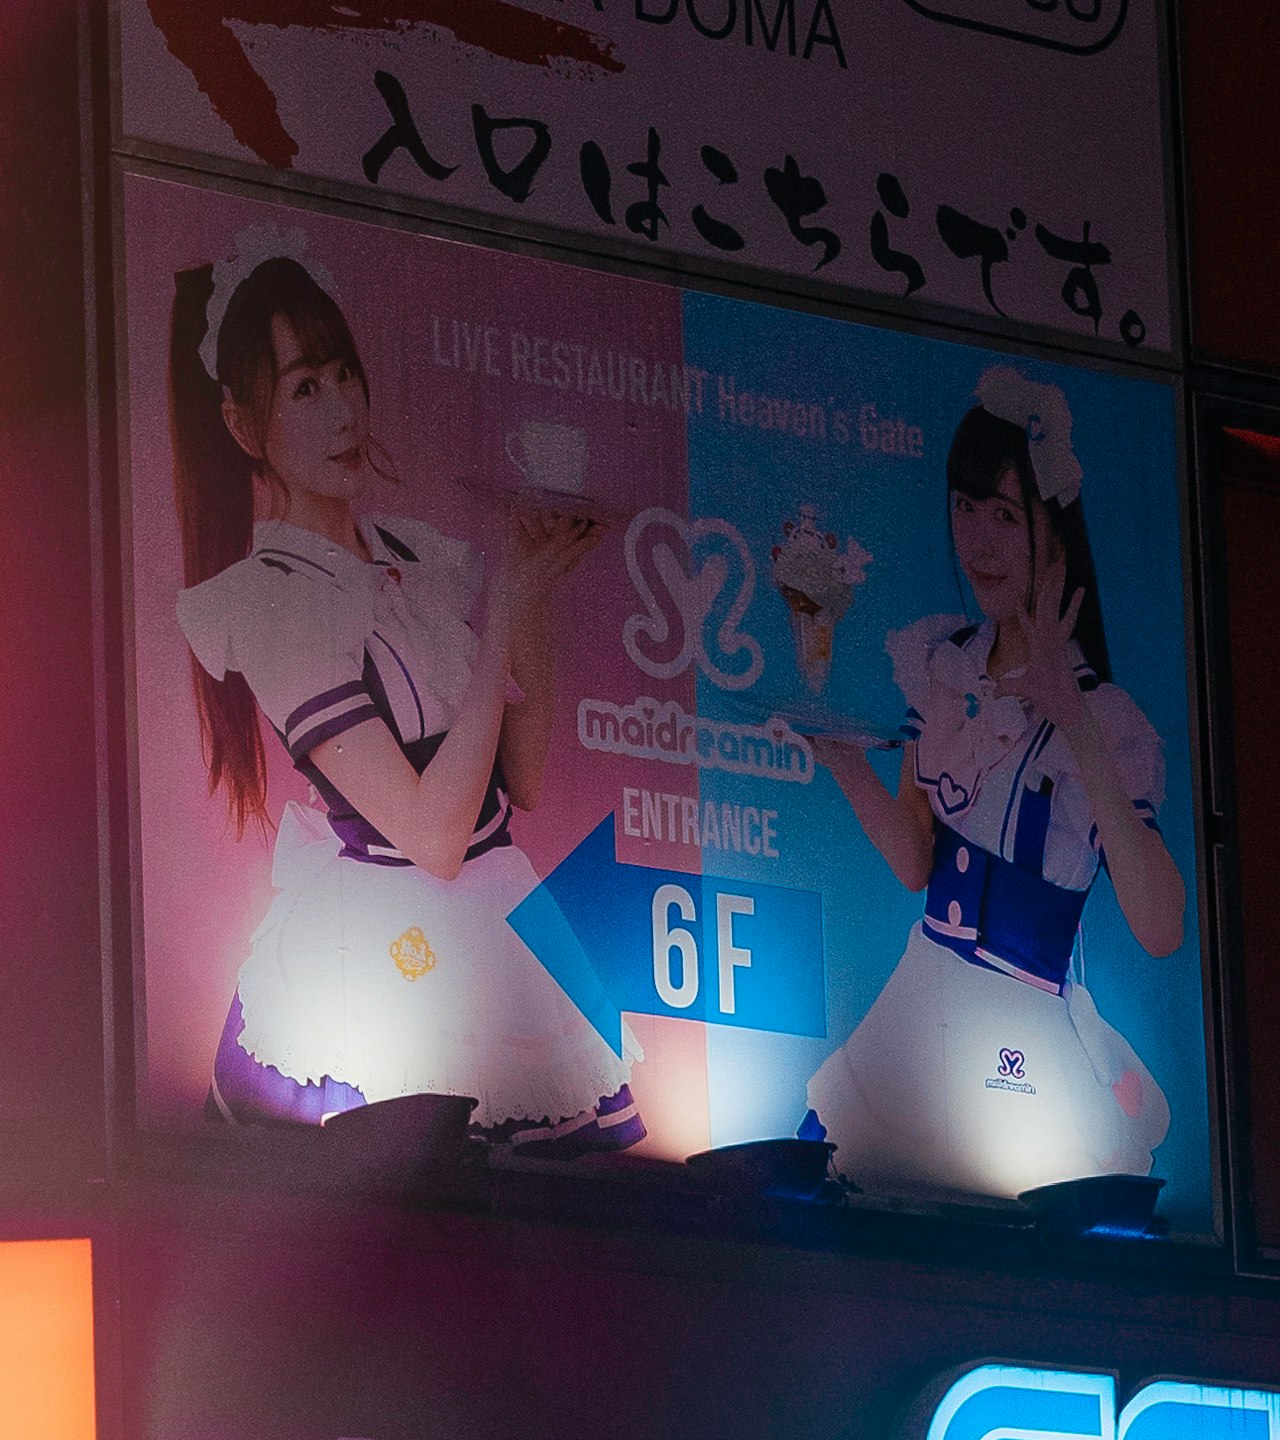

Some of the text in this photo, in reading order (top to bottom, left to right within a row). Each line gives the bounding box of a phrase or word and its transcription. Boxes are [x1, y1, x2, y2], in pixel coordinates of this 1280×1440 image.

[433, 317, 501, 377] LIVE
[511, 333, 709, 415] RESTAURANT
[859, 401, 925, 459] Gate
[581, 701, 811, 780] maidreamin
[624, 787, 780, 859] ENTRANCE
[650, 883, 756, 1016] 6F
